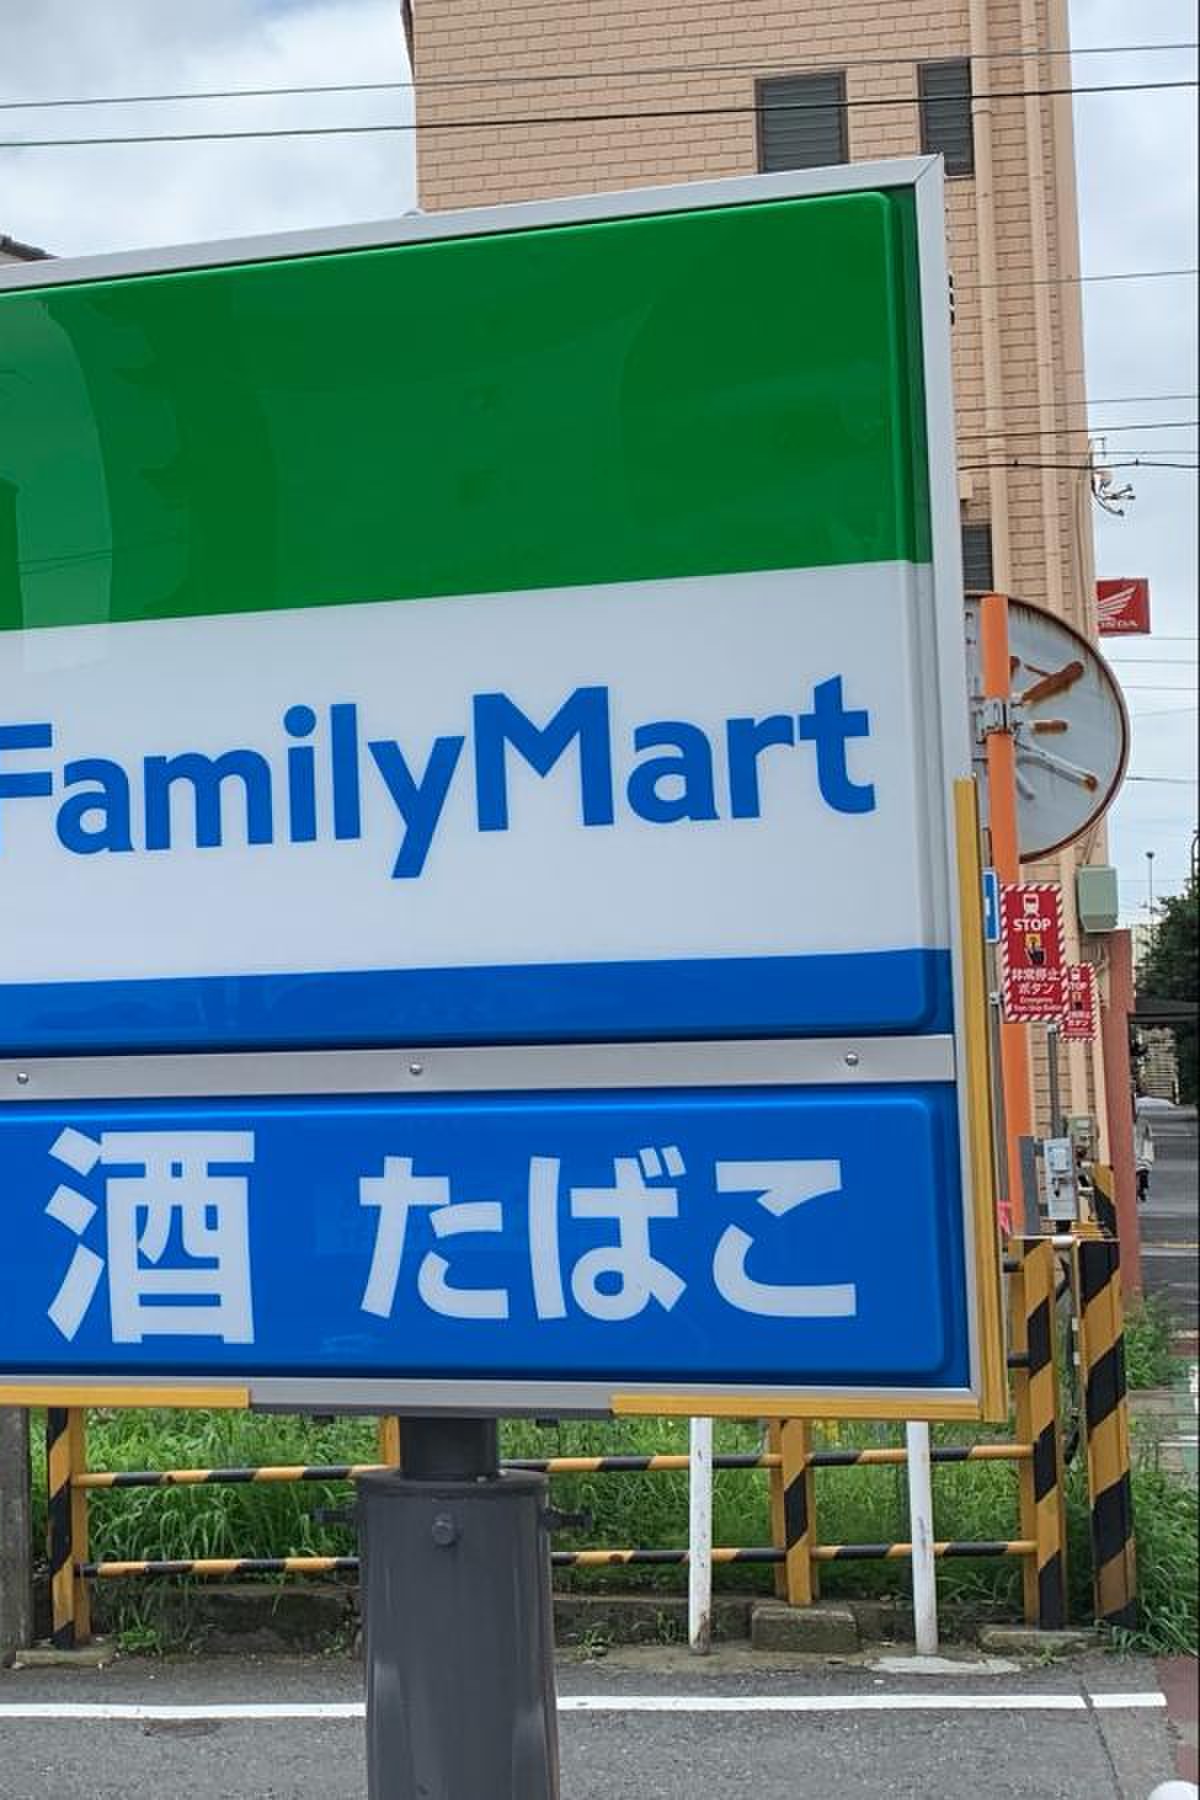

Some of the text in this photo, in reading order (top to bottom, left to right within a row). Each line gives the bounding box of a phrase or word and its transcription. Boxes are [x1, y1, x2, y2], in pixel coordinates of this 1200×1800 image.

[1013, 918, 1052, 931] STOP
[45, 1127, 857, 1345] 酒 たばこ
